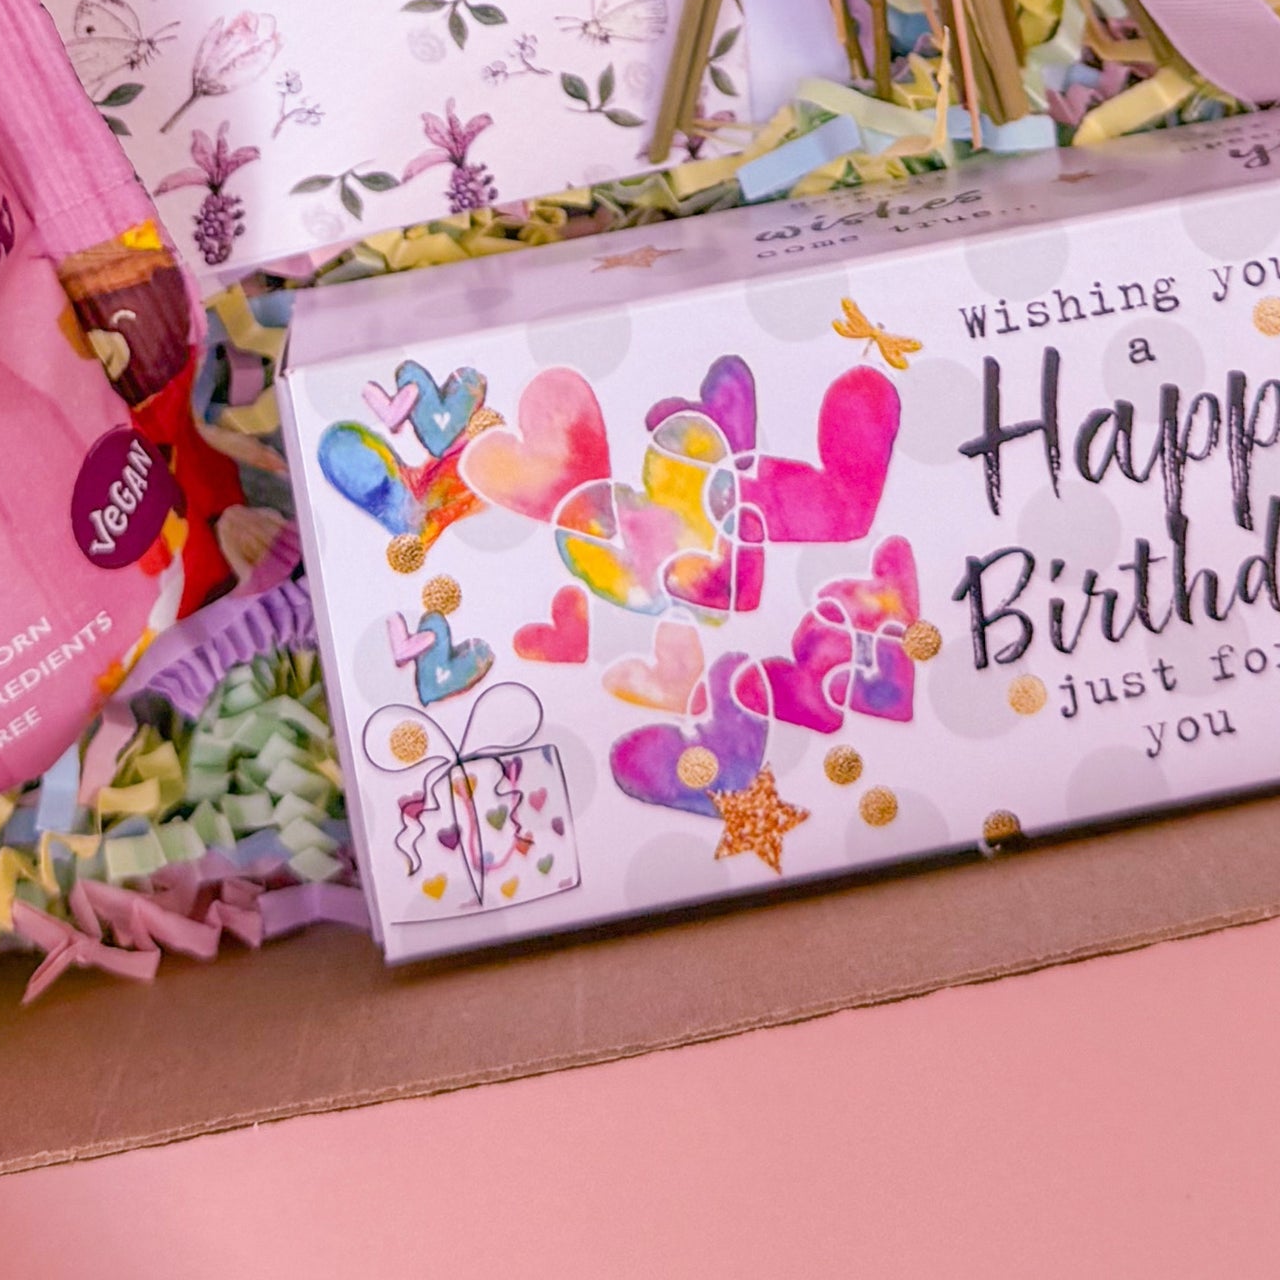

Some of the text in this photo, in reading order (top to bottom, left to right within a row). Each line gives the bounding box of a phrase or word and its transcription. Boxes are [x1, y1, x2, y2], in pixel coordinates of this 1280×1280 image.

[754, 188, 985, 245] wishes
[756, 233, 860, 260] come
[959, 276, 1180, 339] Wishing
[1128, 337, 1157, 365] a
[1058, 658, 1178, 718] just
[1145, 708, 1238, 759] you
